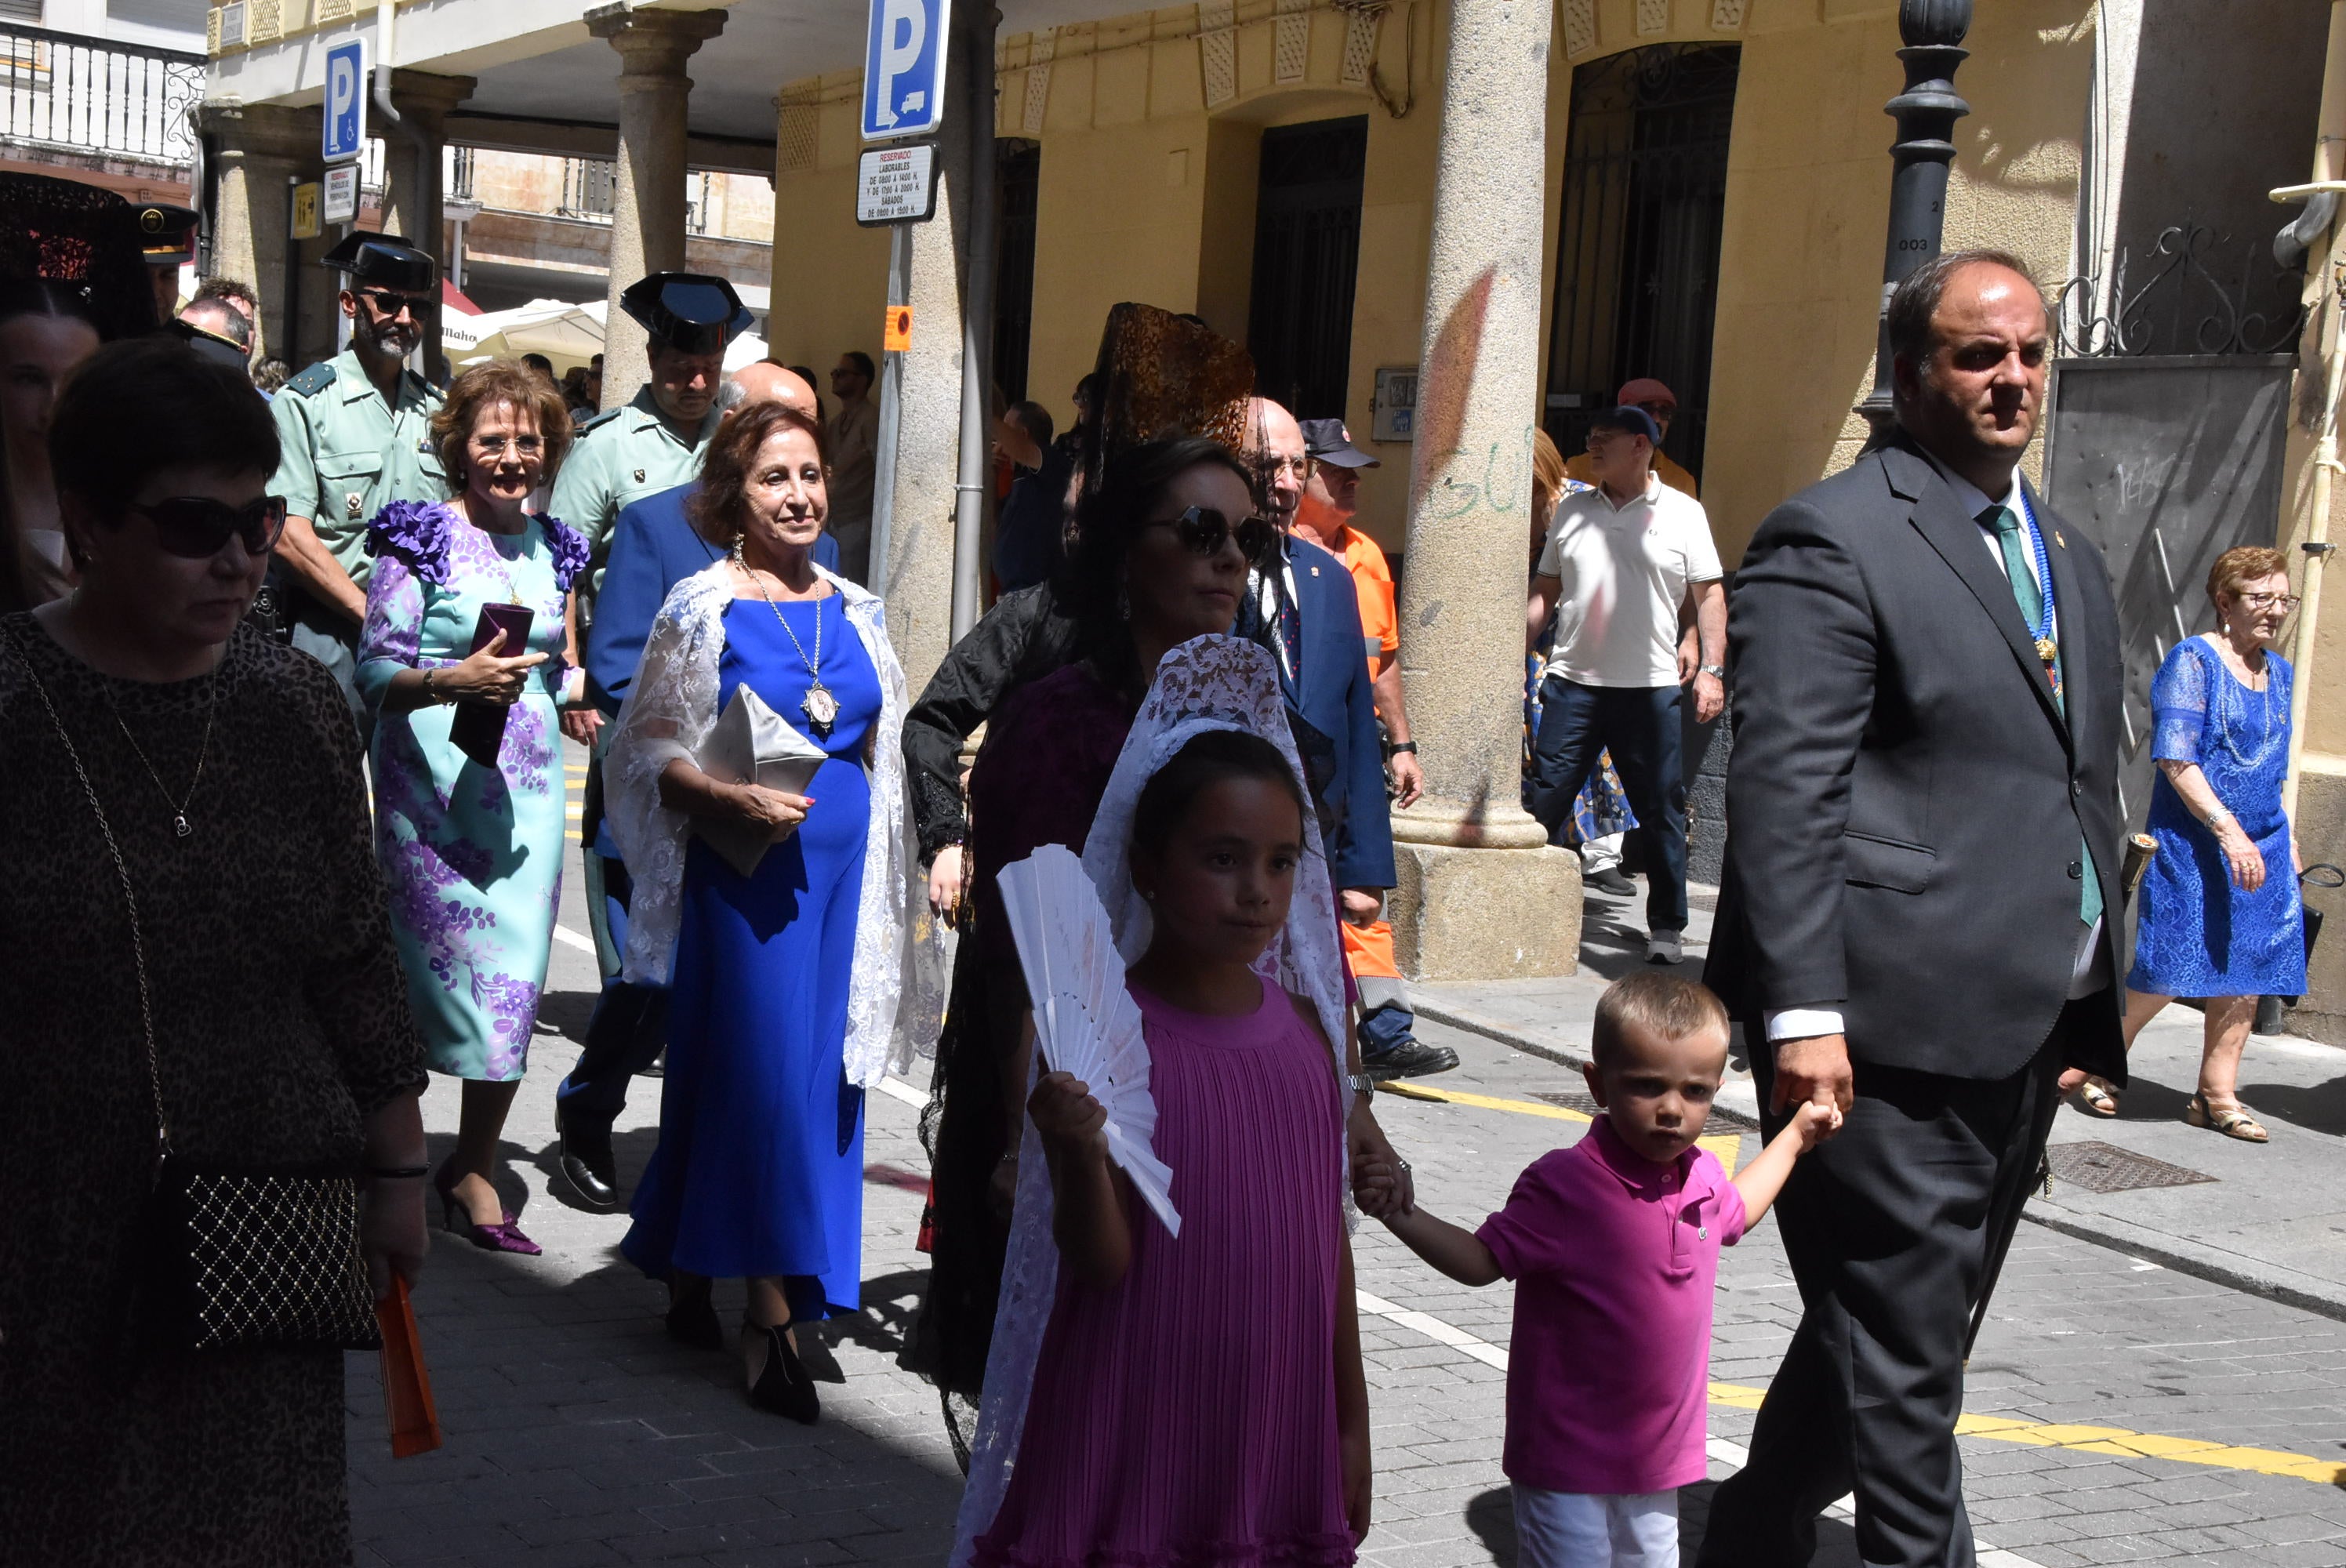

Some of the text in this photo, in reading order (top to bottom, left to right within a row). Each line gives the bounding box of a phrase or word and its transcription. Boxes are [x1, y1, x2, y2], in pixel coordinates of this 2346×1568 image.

[876, 0, 926, 126] P
[330, 56, 354, 146] P
[880, 151, 912, 162] RESERVADO
[879, 162, 910, 173] LABORABLES
[870, 176, 877, 185] DE
[892, 174, 897, 183] A
[866, 187, 870, 196] Y
[872, 187, 879, 196] DE
[895, 184, 899, 194] A
[867, 209, 874, 218] DE
[891, 206, 895, 216] A
[1931, 200, 1939, 212] 2
[1899, 238, 1928, 251] 003
[441, 327, 478, 343] Maho
